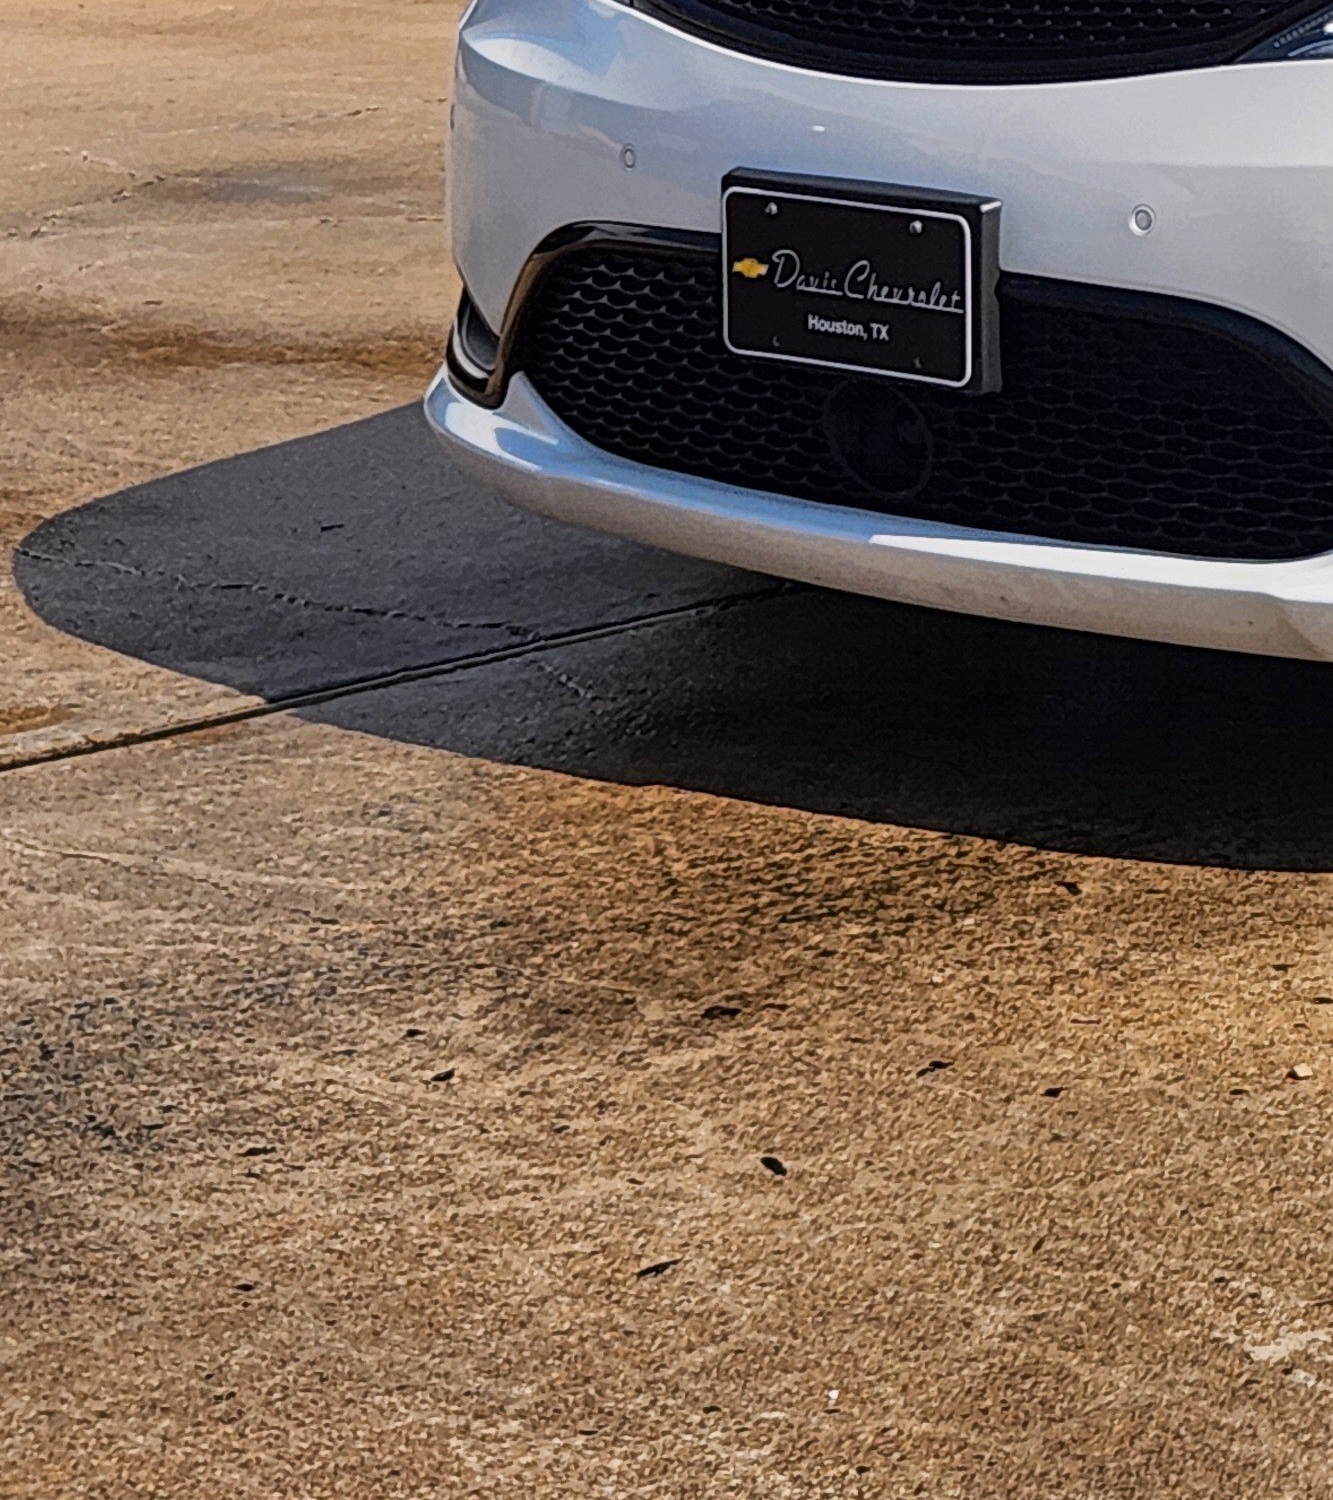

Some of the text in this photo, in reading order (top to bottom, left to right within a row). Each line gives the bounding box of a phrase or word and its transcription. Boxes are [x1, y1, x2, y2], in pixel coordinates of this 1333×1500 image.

[771, 249, 964, 314] Davis Chevrolet
[807, 313, 890, 341] Houston, TX
